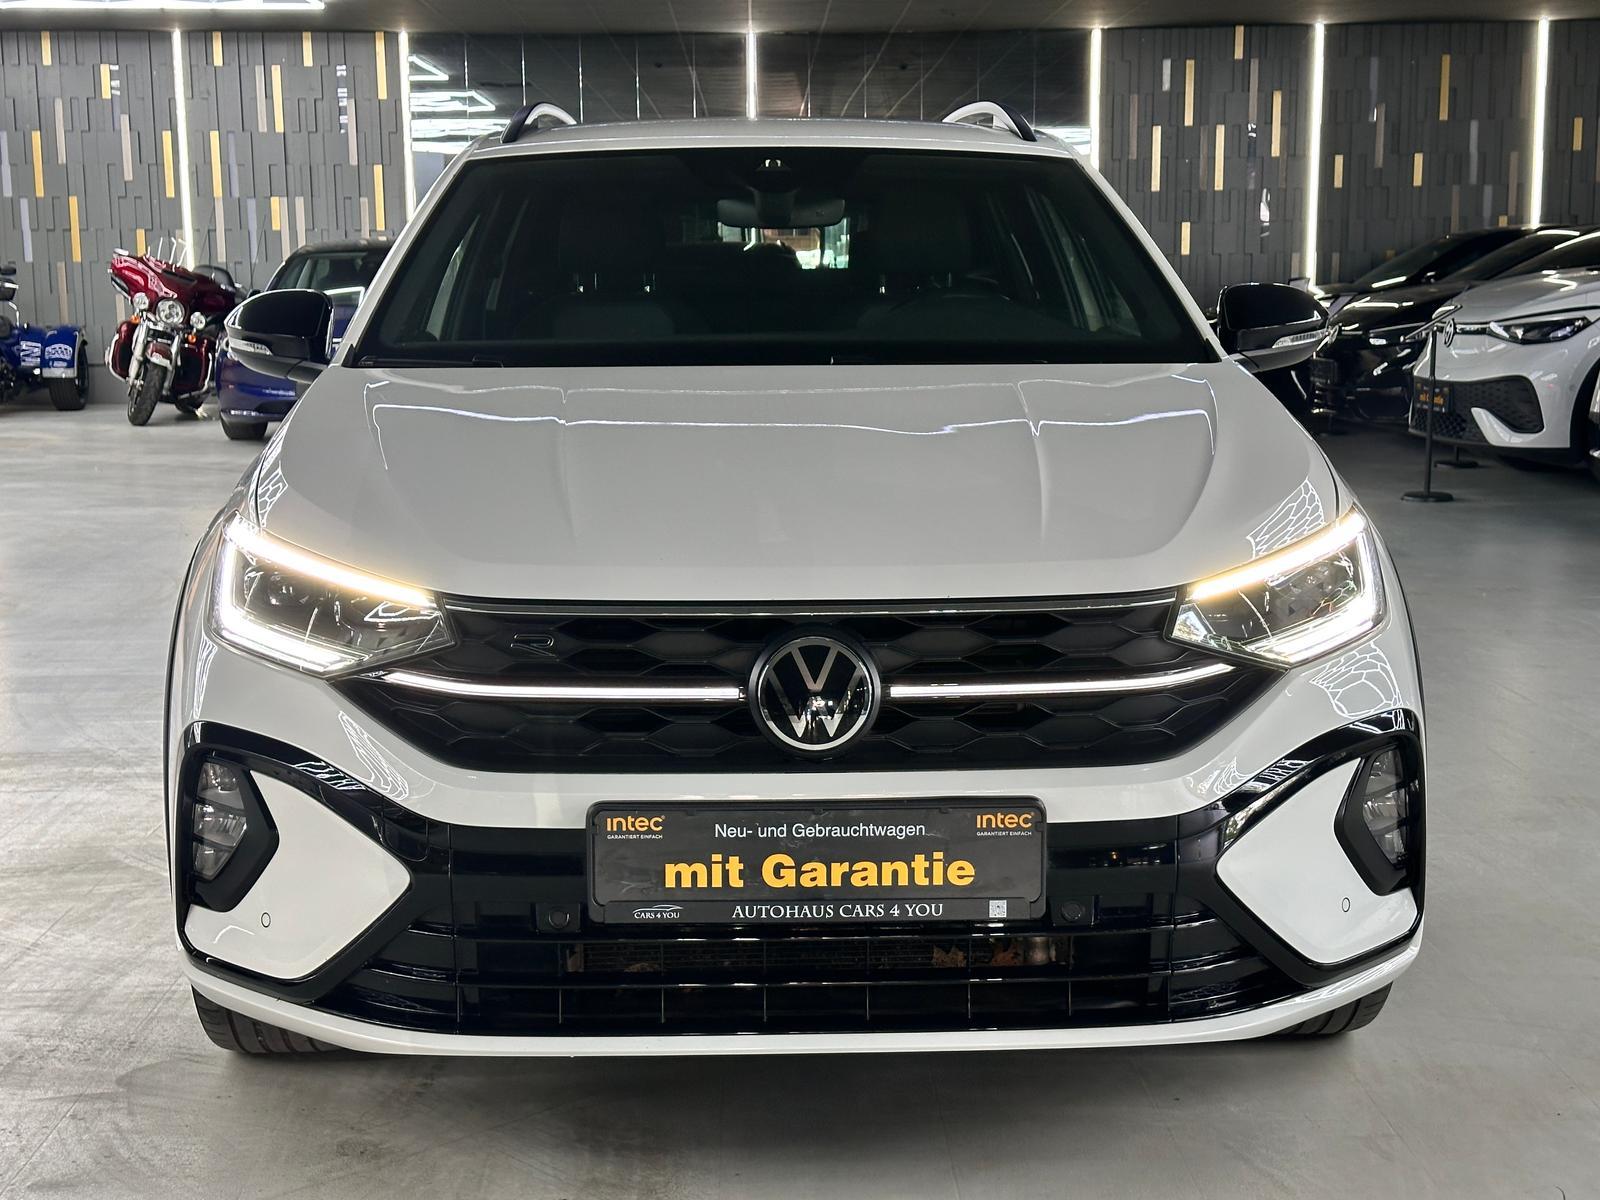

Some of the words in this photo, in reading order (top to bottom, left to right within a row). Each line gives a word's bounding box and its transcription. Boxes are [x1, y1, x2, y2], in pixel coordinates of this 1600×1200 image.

[714, 823, 753, 838] Neu-
[757, 823, 787, 838] und
[792, 823, 926, 839] Gebrauchtwagen
[664, 853, 744, 889] mit
[761, 851, 976, 888] Garantie
[662, 911, 681, 919] YOU
[731, 904, 834, 919] AUTOHAUS
[839, 904, 885, 918] CARS
[889, 904, 900, 917] 4
[904, 903, 944, 917] YOU
